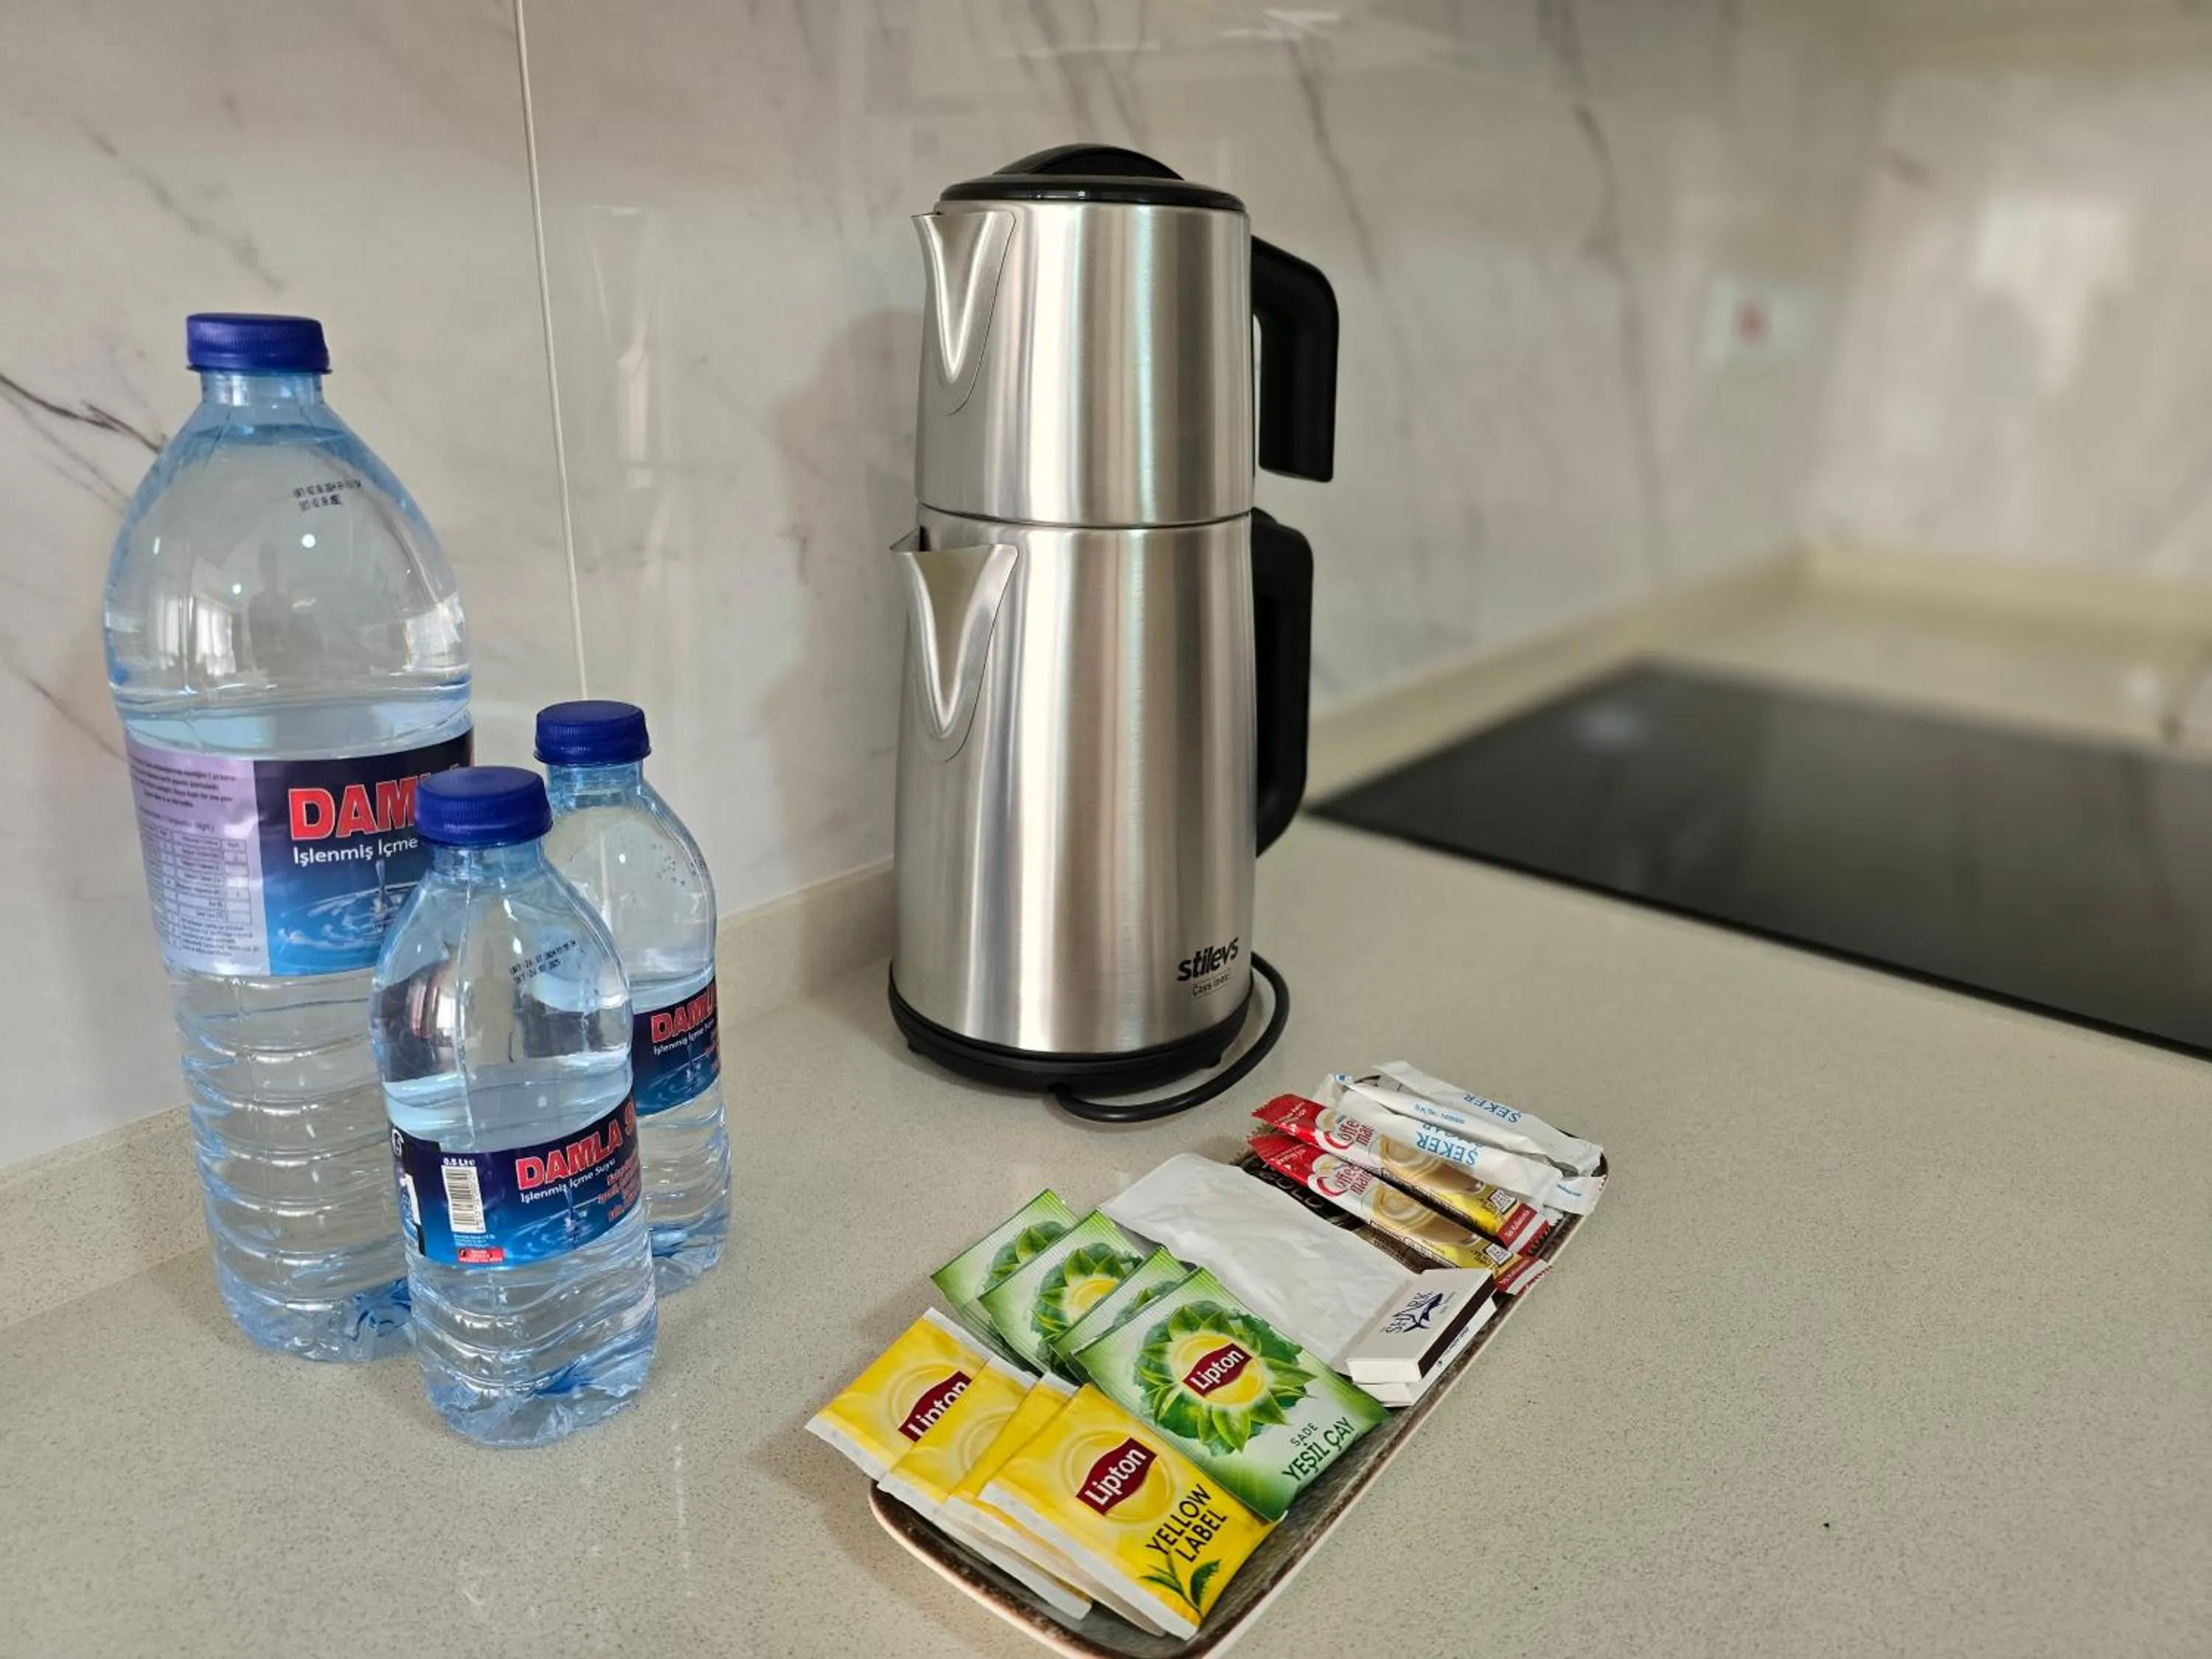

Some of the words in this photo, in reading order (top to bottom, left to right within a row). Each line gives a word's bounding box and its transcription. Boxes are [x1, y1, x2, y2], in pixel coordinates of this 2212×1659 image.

[515, 1119, 623, 1190] DAMLA
[1189, 1349, 1245, 1389] Lipton
[908, 1381, 967, 1437] Lipton
[1290, 1422, 1318, 1445] SADE
[1282, 1443, 1330, 1482] YEŞİL
[1323, 1416, 1355, 1452] ÇAY
[1084, 1449, 1147, 1506] Lipton
[1145, 1483, 1211, 1555] YELLOW
[1175, 1509, 1228, 1563] LABEL
